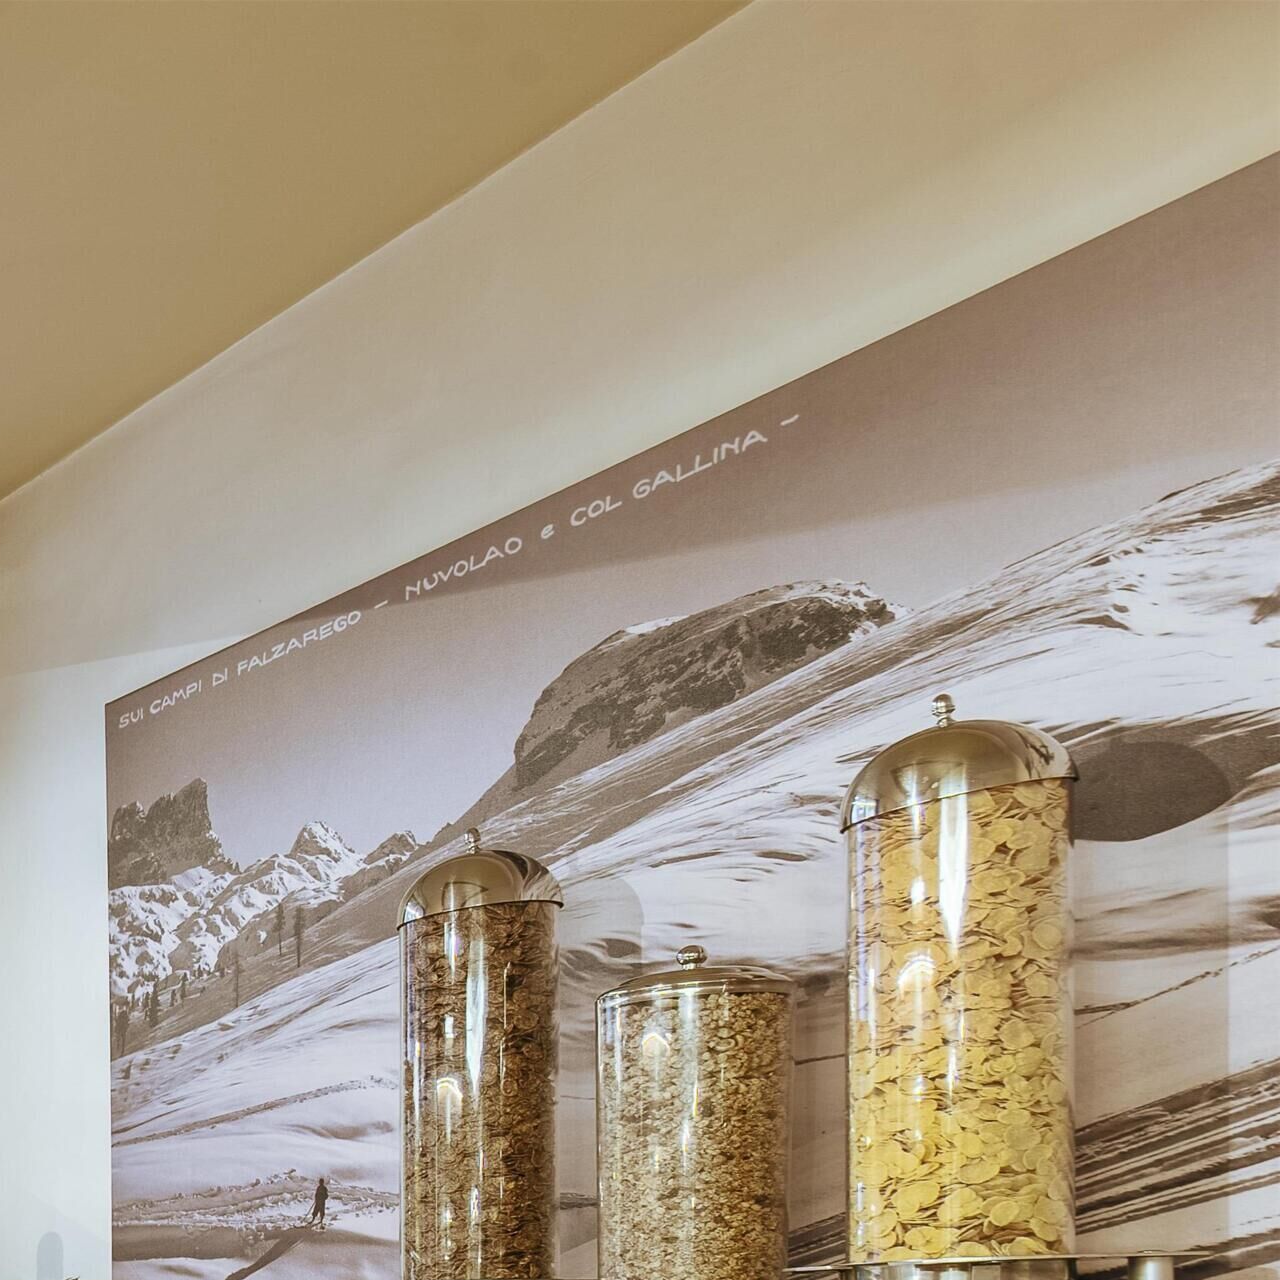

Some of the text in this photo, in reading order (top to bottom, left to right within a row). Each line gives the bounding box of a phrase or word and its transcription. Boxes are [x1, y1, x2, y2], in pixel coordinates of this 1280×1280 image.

[119, 708, 143, 728] SUI
[150, 680, 202, 714] CAMPI
[212, 668, 228, 687] DI
[237, 610, 361, 676] FALZAREGO
[406, 537, 522, 600] NUVOLAO
[541, 523, 555, 540] e
[570, 496, 623, 527] COL
[632, 430, 768, 499] GALLINA
